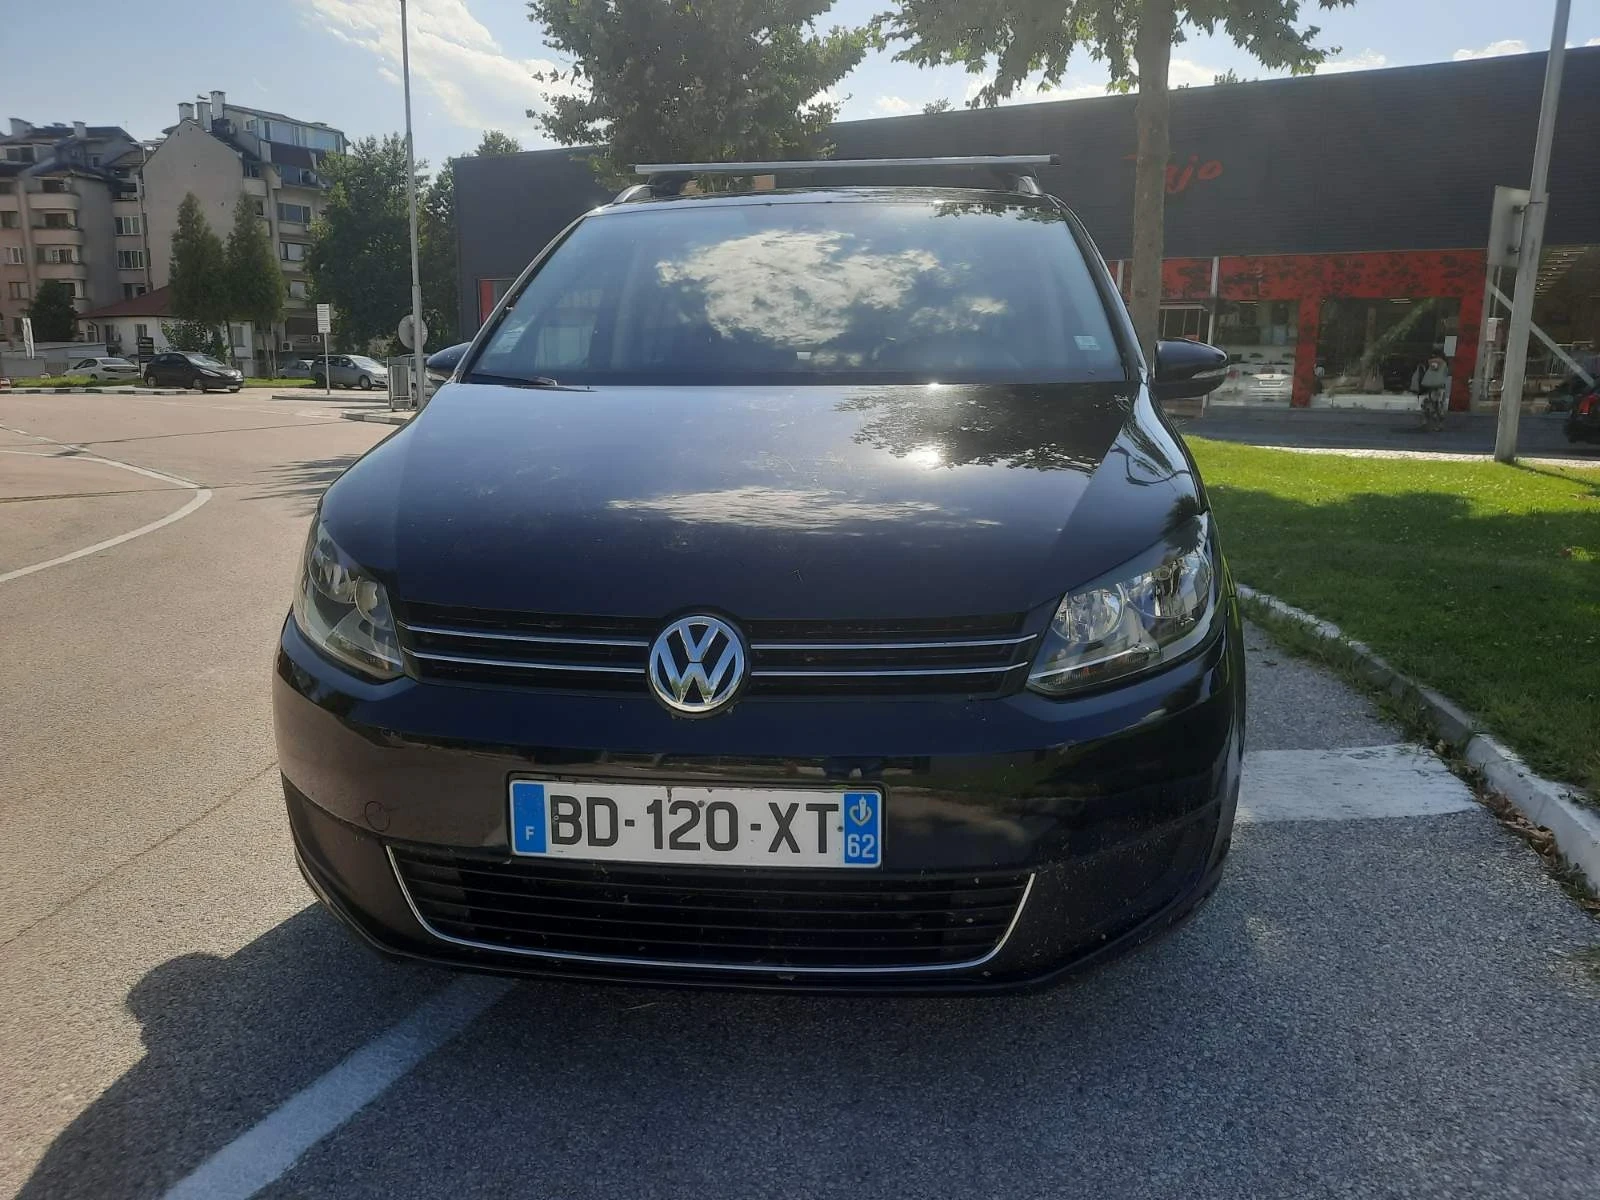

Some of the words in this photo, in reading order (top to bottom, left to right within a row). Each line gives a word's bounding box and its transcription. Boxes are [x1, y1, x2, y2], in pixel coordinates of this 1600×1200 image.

[525, 825, 535, 841] F
[550, 794, 839, 854] BD-120-XT
[847, 833, 875, 858] 62
